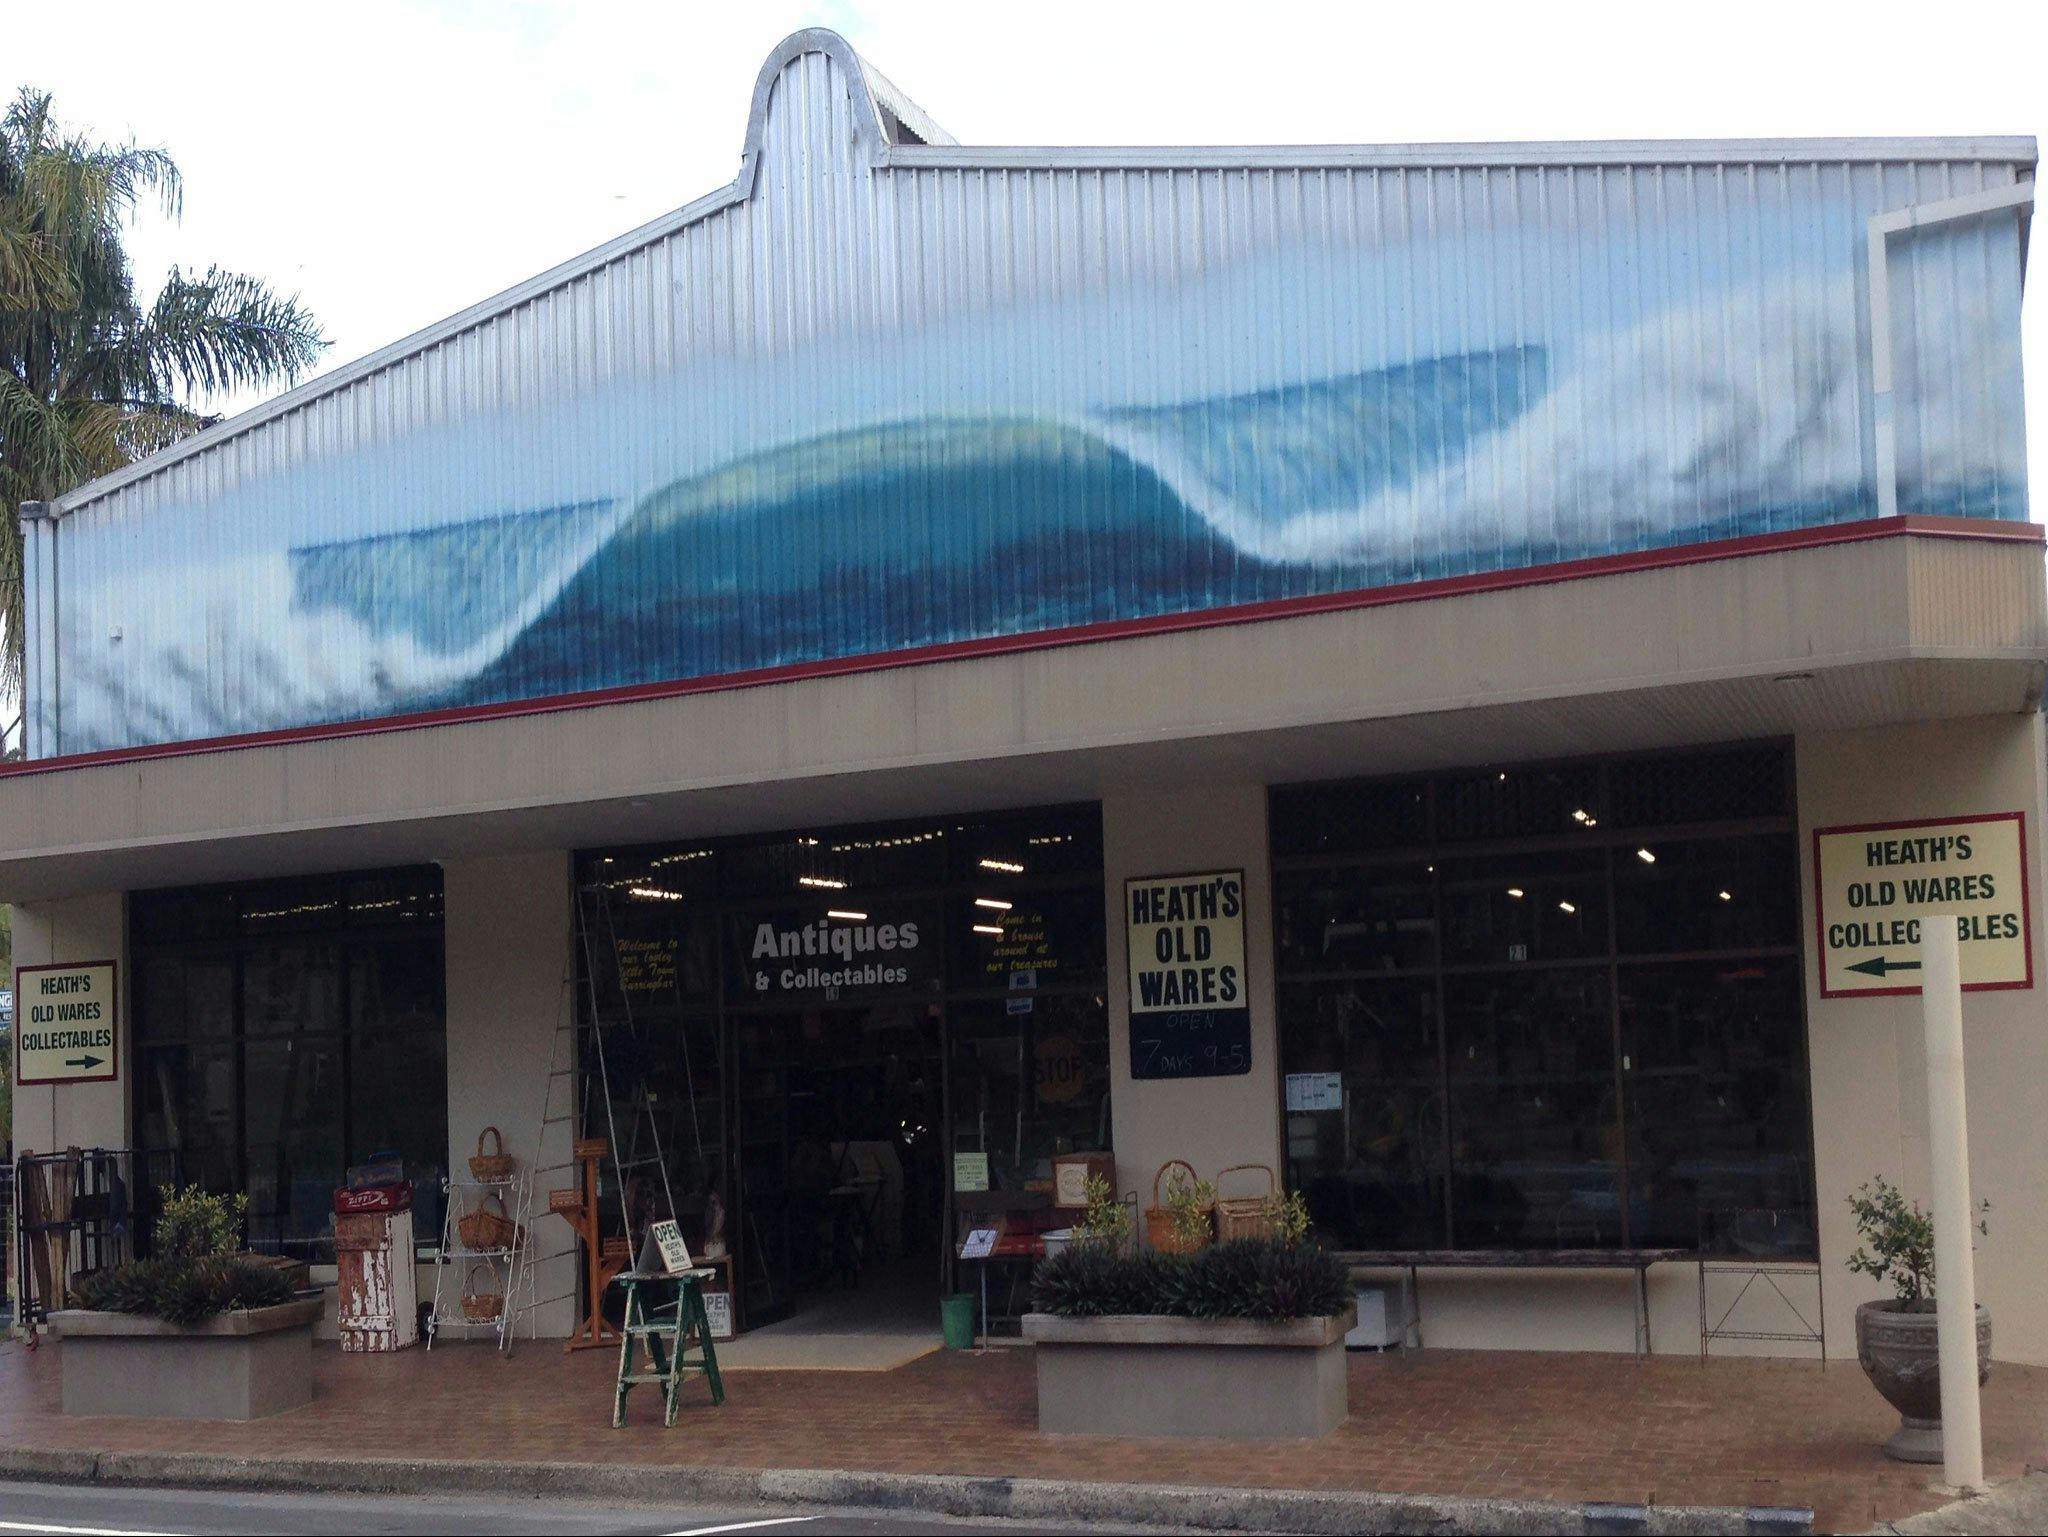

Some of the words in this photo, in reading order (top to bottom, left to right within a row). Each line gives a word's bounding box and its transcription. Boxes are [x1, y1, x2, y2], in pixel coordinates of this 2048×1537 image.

[1866, 835, 1973, 867] HEATH'S
[1132, 877, 1240, 924] HEATH'S
[1847, 881, 1896, 908] OLD
[1903, 873, 1996, 904] WARES
[752, 919, 920, 961] Antiques
[1155, 925, 1211, 964] OLD
[1828, 913, 2020, 950] COLLECBLES
[40, 974, 91, 995] HEATH'S
[755, 970, 770, 991] &
[780, 963, 908, 989] Collectables
[1138, 965, 1238, 1007] WARES
[31, 1005, 54, 1023] OLD
[57, 1001, 101, 1021] WARES
[1166, 1012, 1215, 1031] OPEN
[21, 1029, 112, 1051] COLLECTABLES
[1141, 1039, 1161, 1073] 7
[1161, 1055, 1193, 1072] DAYS
[705, 1295, 729, 1310] PEN
